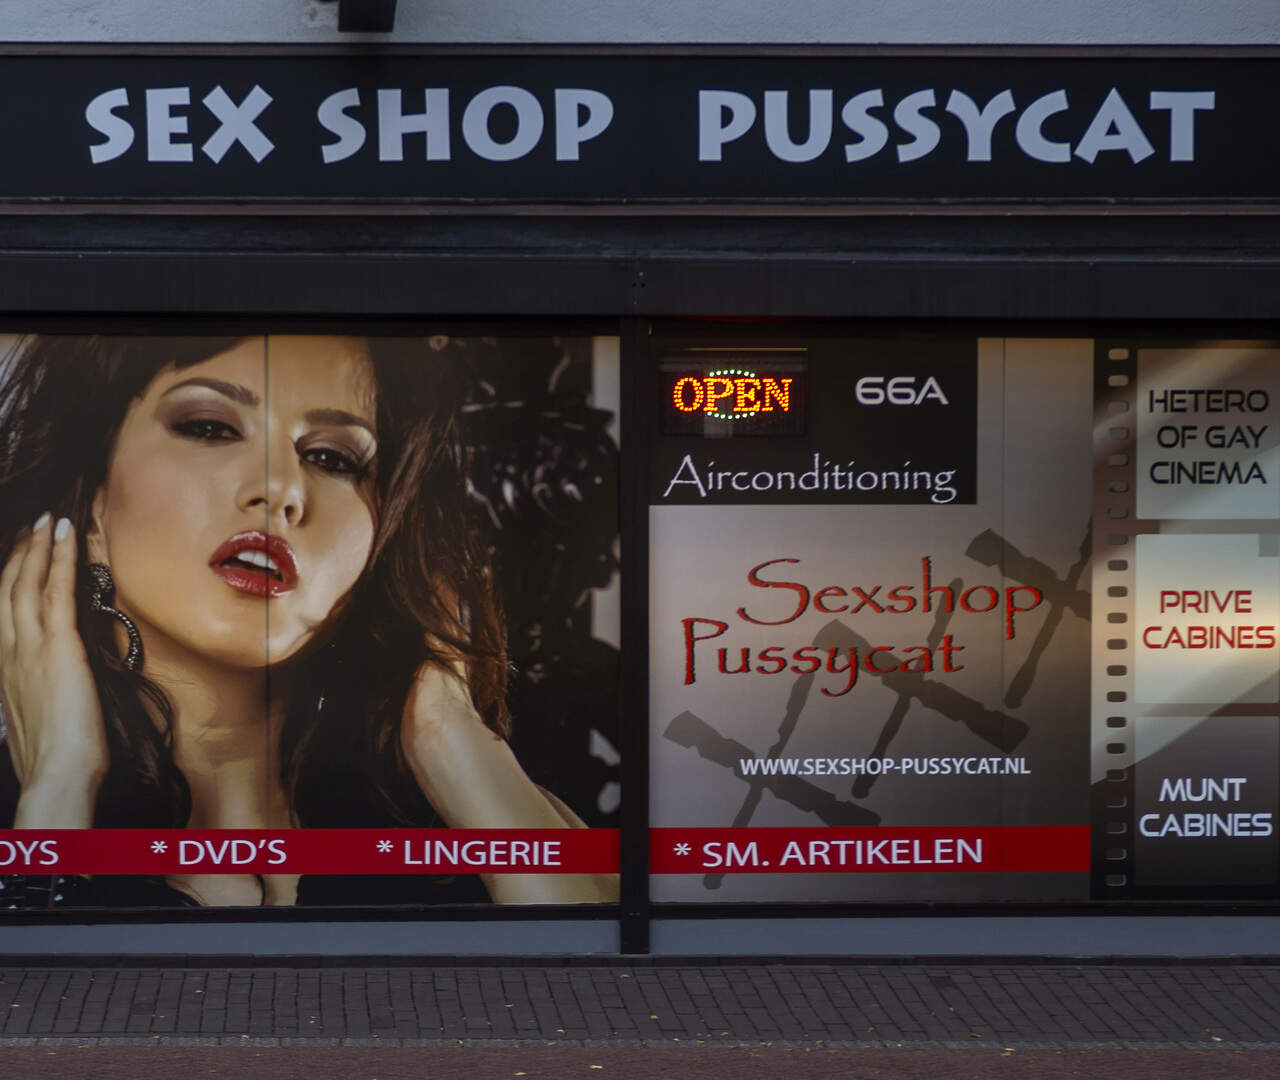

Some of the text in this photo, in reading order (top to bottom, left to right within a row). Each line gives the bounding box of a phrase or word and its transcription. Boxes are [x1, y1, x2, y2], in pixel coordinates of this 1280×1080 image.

[84, 83, 1217, 165] SEX SHOP PUSSYCAT
[671, 376, 793, 413] OPEN
[854, 375, 950, 406] 66A
[1148, 388, 1270, 414] HETERO
[1156, 424, 1269, 450] OF GAY
[662, 452, 958, 504] Airconditioning
[1149, 460, 1268, 485] CINEMA
[736, 555, 1044, 640] Sexshop
[1159, 589, 1253, 614] PRIVE
[1142, 625, 1277, 650] CABINES
[680, 617, 966, 697] Pussycat
[739, 757, 1032, 777] WWW.SEXSHOP-PUSSYCAT.NL
[1159, 777, 1248, 802] MUNT
[1138, 812, 1274, 838] CABINES
[178, 838, 288, 866] DVD'S
[403, 839, 562, 867] LINGERIE
[701, 837, 984, 868] SM. ARTIKELEN
